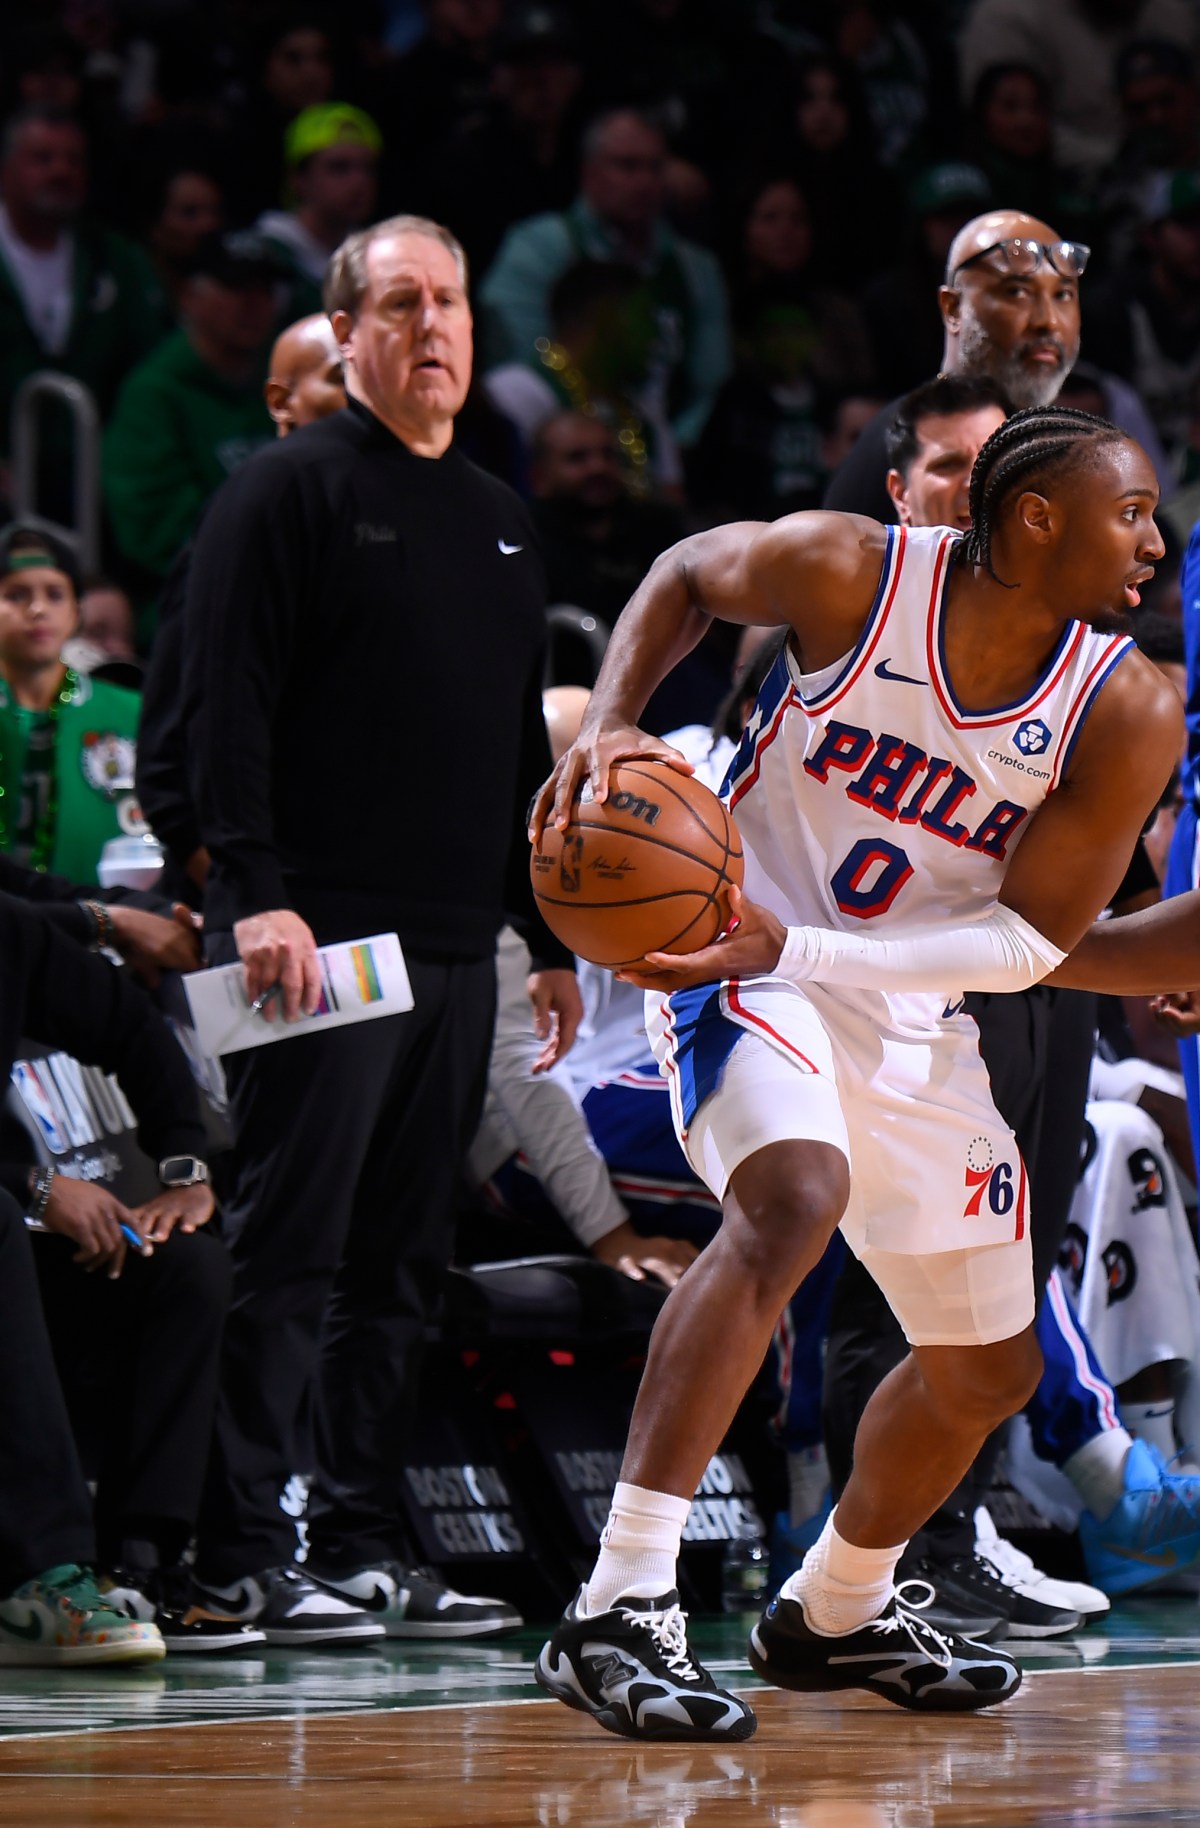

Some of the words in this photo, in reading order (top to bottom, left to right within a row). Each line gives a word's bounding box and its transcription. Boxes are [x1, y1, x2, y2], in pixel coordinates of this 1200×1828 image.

[803, 720, 1029, 862] PHILA
[987, 748, 1051, 780] crypto.com
[830, 838, 915, 919] 0
[963, 1162, 1014, 1218] 76
